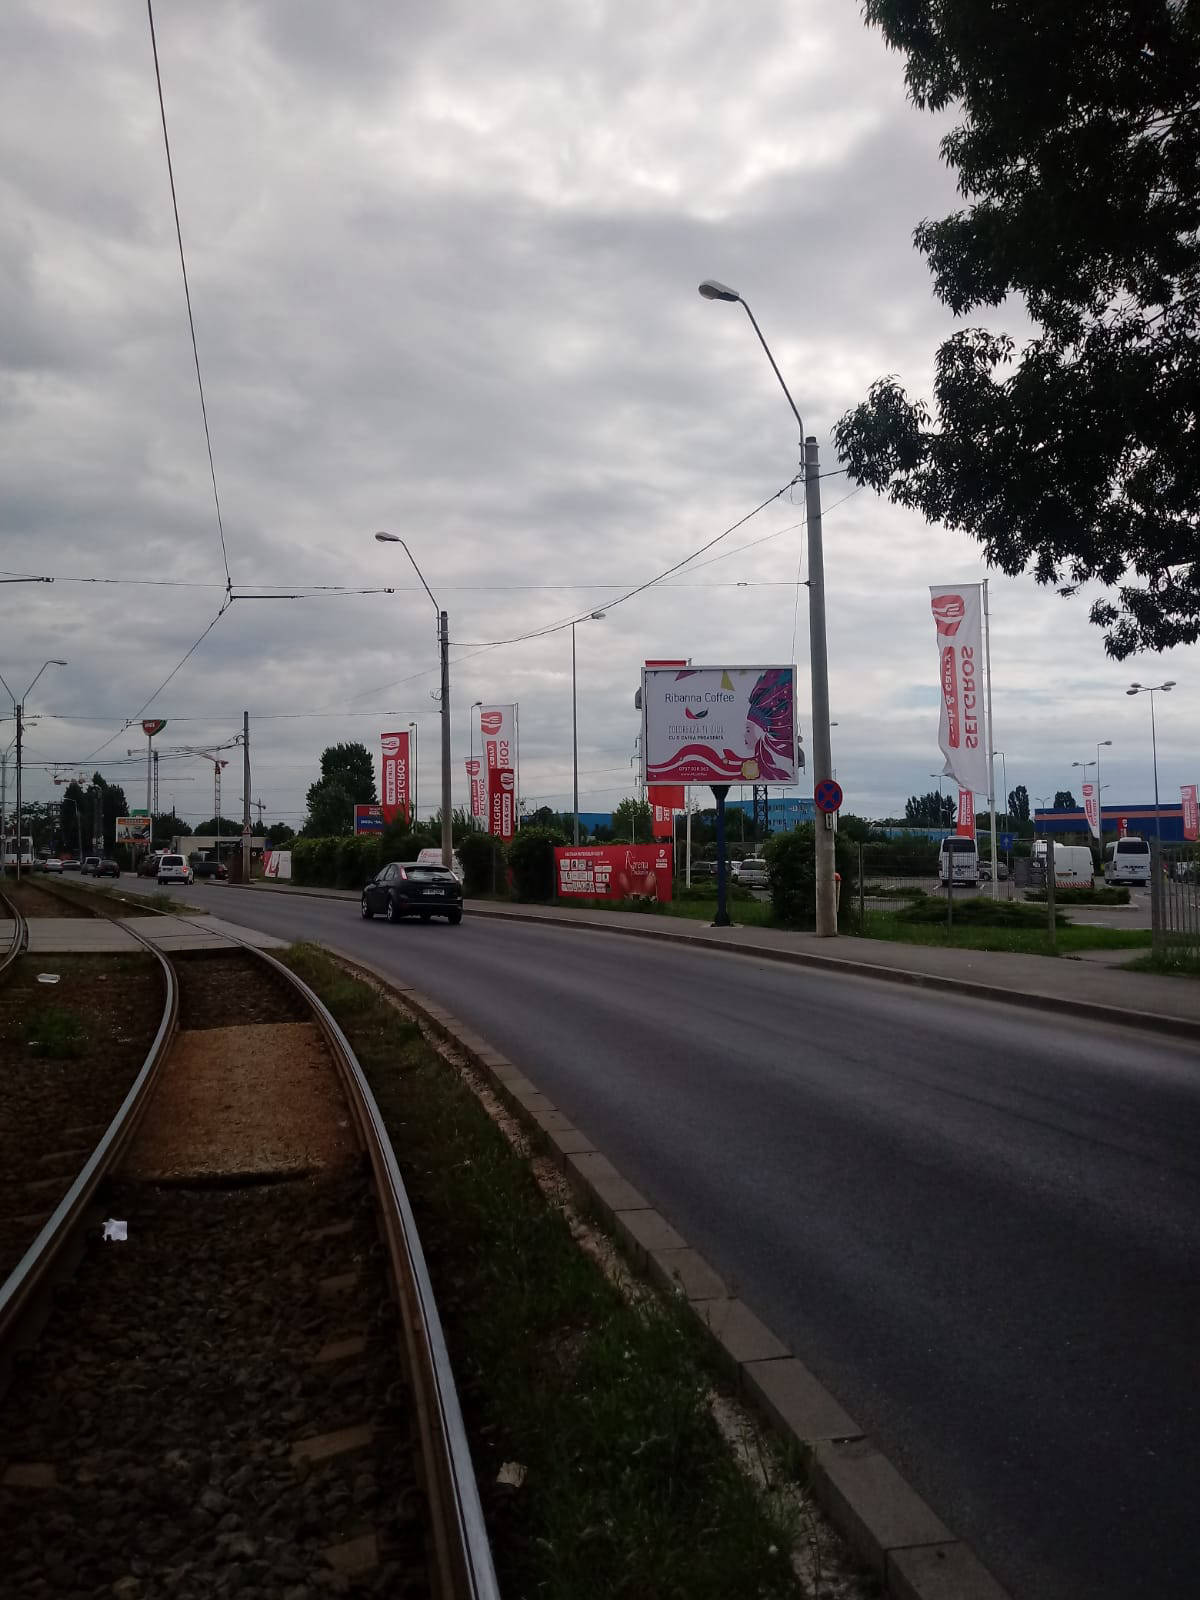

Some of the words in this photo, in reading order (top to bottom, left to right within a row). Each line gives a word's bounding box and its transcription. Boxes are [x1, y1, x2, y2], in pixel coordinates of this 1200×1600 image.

[665, 692, 702, 703] Ribanna
[705, 692, 735, 703] Coffee
[493, 793, 501, 836] SELGROS
